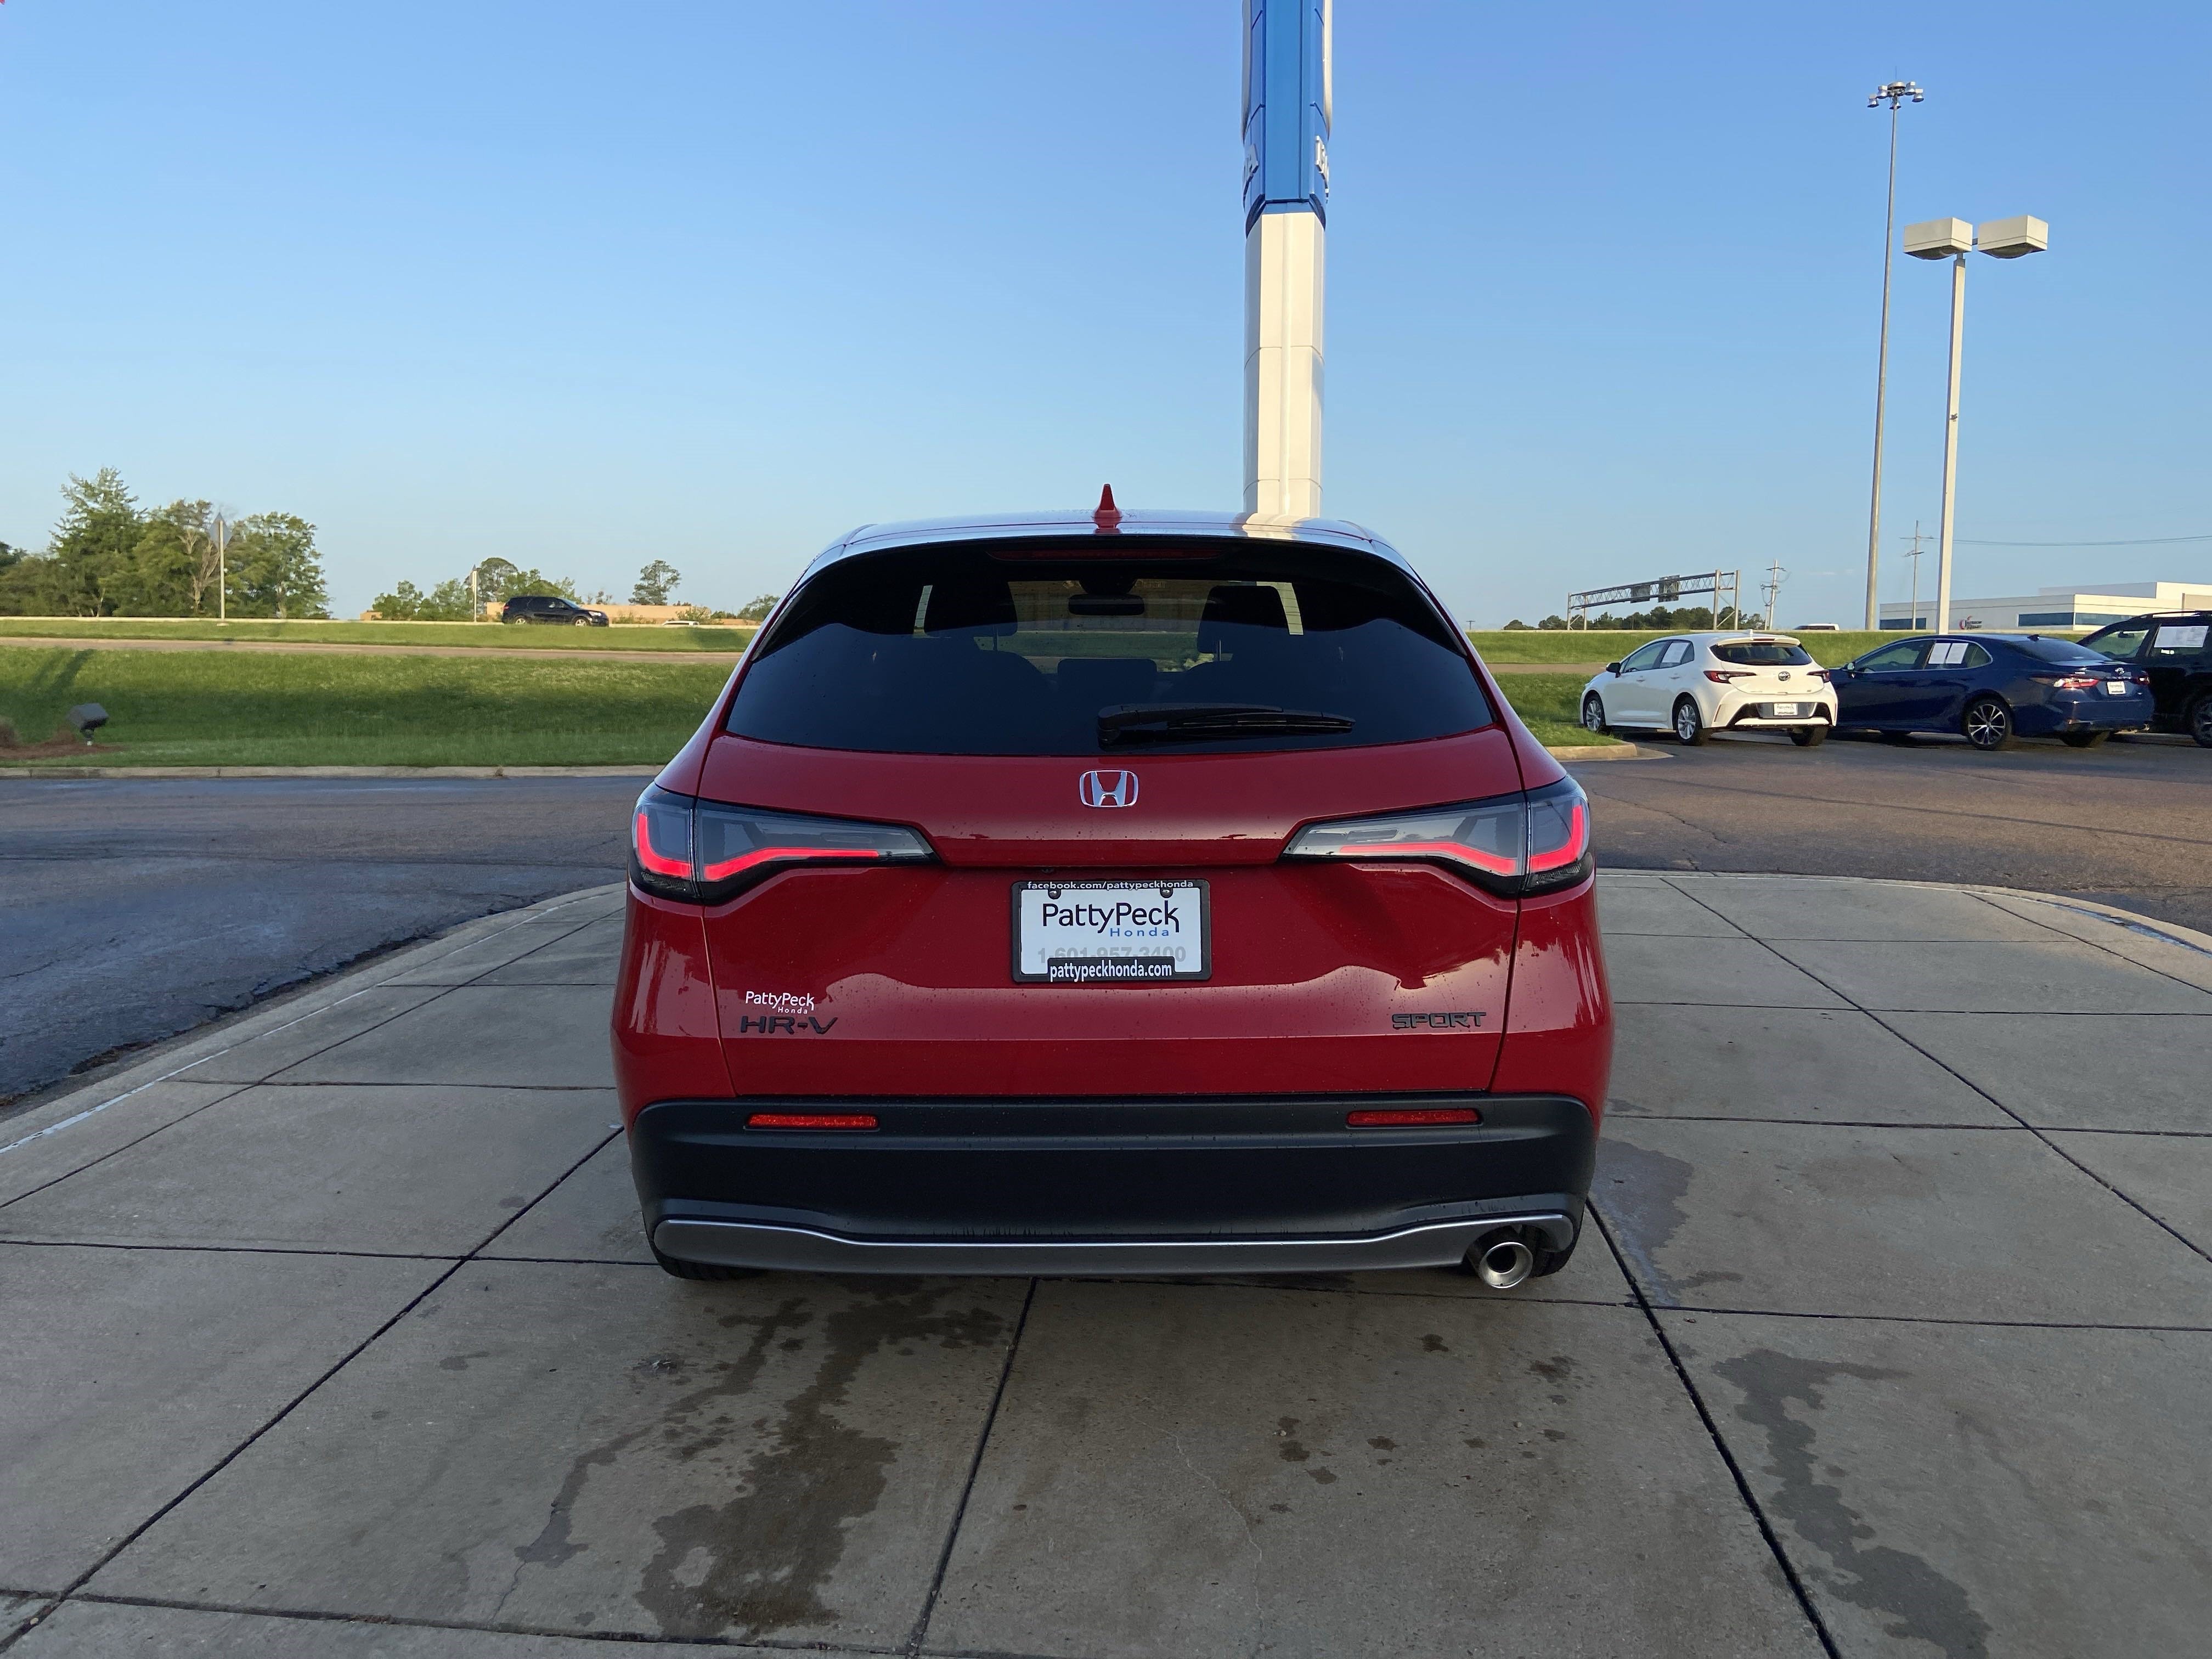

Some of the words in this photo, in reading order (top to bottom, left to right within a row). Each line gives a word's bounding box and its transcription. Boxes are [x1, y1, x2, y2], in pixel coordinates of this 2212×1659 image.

[1027, 880, 1194, 890] facebook.com/pattypeckhonda
[1042, 900, 1180, 934] PattyPeck
[1110, 927, 1170, 937] Honda
[1049, 959, 1172, 982] pattypeckhonda.com
[744, 991, 815, 1011] PattyPeck
[777, 1006, 808, 1014] Honda
[741, 1015, 838, 1035] HR-V
[1391, 1012, 1487, 1030] SPORT
